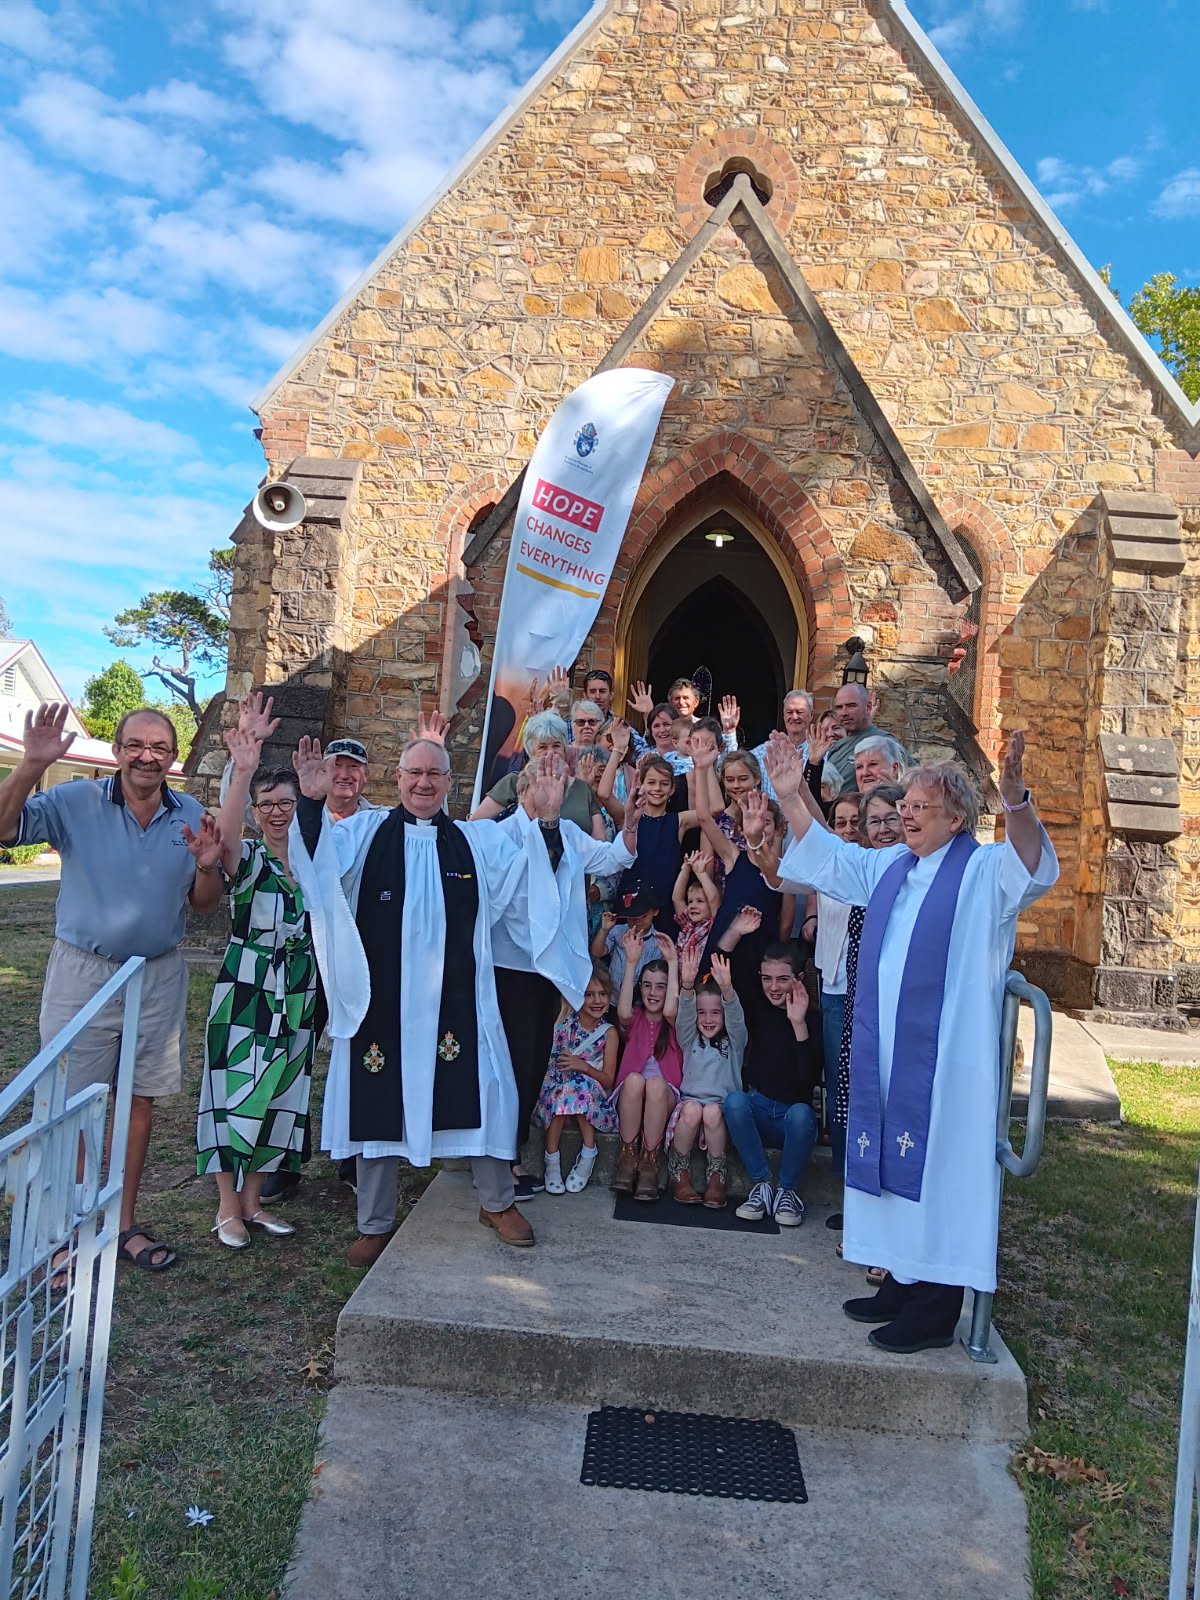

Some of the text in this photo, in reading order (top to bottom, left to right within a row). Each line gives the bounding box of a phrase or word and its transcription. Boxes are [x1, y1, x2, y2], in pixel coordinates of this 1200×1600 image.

[536, 486, 598, 526] HOPE
[526, 516, 592, 555] CHANGES
[520, 540, 606, 586] EVERYTHING
